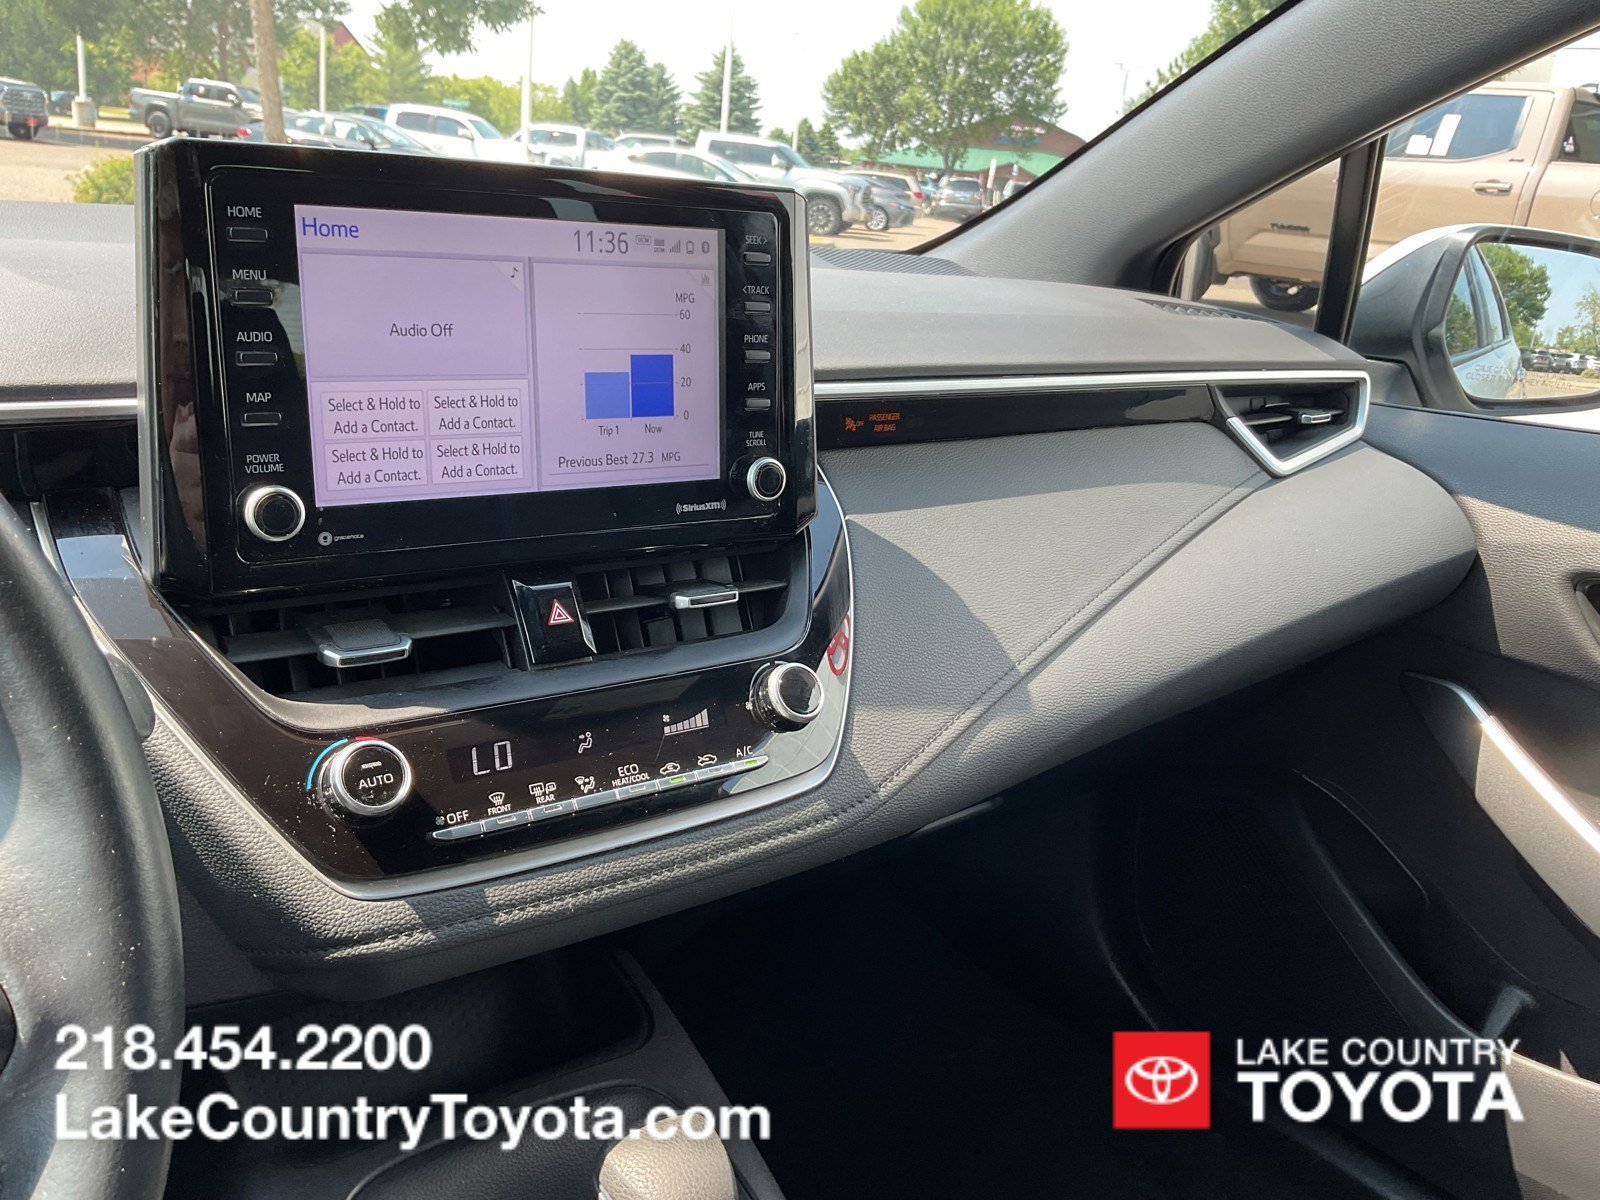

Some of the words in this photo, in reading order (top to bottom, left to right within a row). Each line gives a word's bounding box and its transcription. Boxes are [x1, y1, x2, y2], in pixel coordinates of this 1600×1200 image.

[227, 206, 262, 218] HOME
[302, 217, 359, 238] Home
[573, 229, 629, 254] 11:36
[232, 269, 267, 280] MENU
[675, 292, 695, 304] MPG
[679, 309, 691, 320] 60
[389, 323, 427, 337] Audio
[430, 323, 454, 337] Off
[236, 331, 273, 342] AUDIO
[744, 334, 768, 343] PHONE
[679, 343, 691, 354] 40
[680, 377, 692, 387] 20
[747, 382, 766, 391] APPS
[246, 392, 272, 403] MAP
[434, 396, 466, 409] Select
[469, 395, 477, 408] &
[480, 395, 505, 408] Hold
[507, 396, 518, 407] to
[328, 398, 363, 412] Select
[367, 397, 376, 411] &
[379, 397, 406, 410] Hold
[409, 398, 421, 410] to
[683, 410, 689, 420] 0
[869, 412, 900, 421] PASSENGER
[333, 421, 358, 434] Add
[361, 423, 368, 433] a
[371, 419, 419, 433] Contact.
[438, 417, 461, 430] Add
[464, 420, 470, 429] a
[472, 416, 516, 429] Contact.
[644, 424, 662, 434] Now
[598, 425, 613, 436] Trip
[746, 438, 767, 447] SCROLL
[331, 449, 367, 463] Select
[370, 448, 379, 461] &
[382, 447, 409, 460] Hold
[412, 447, 424, 459] to
[436, 445, 468, 458] Select
[471, 443, 480, 456] &
[482, 442, 507, 455] Hold
[509, 443, 520, 454] to
[246, 453, 280, 464] POWER
[558, 456, 603, 468] Previous
[605, 454, 628, 465] Best
[632, 452, 654, 464] 27.3
[661, 451, 681, 461] MPG
[245, 463, 284, 474] VOLUME
[441, 466, 463, 479] Add
[466, 468, 472, 477] a
[475, 464, 518, 477] Contact.
[337, 471, 361, 485] Add
[364, 474, 371, 483] a
[374, 469, 421, 483] Contact.
[736, 745, 753, 757] A/C
[617, 763, 639, 777] ECO
[358, 773, 394, 790] AUTO
[612, 773, 650, 787] HEAT/COOL
[536, 793, 555, 804] REAR
[487, 803, 512, 816] FRONT
[446, 810, 469, 824] OFF
